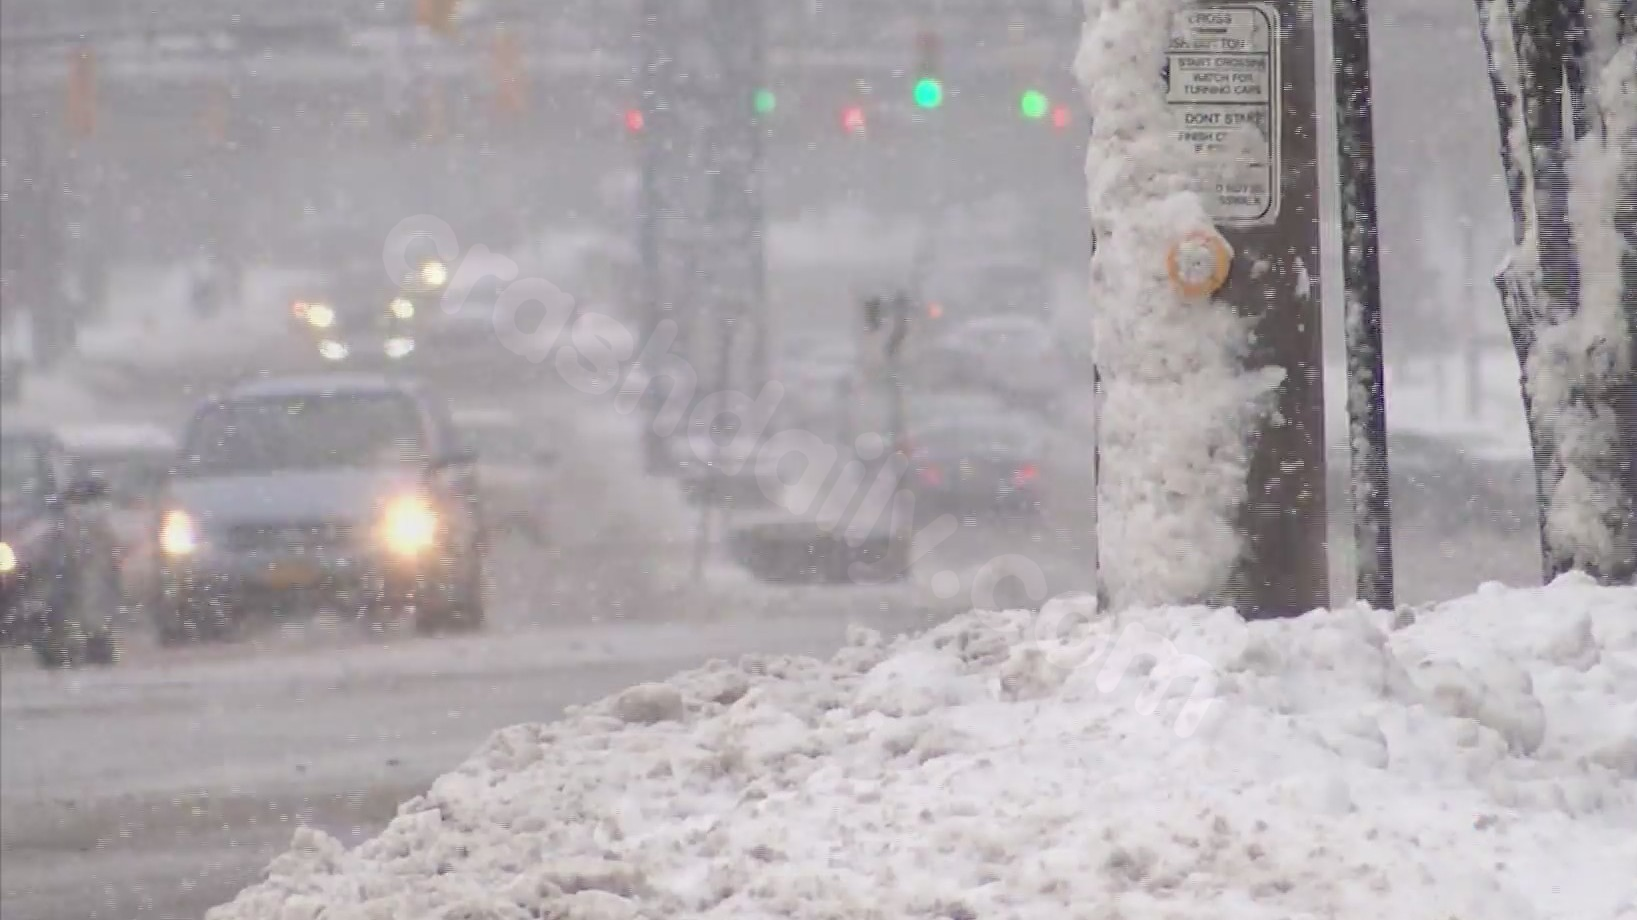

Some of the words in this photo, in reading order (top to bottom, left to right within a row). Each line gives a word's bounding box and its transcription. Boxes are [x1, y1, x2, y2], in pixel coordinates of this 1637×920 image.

[1193, 73, 1229, 82] WATCH
[1232, 73, 1253, 82] FOR
[1184, 85, 1231, 95] TURNING
[1234, 85, 1261, 95] CARS
[1185, 113, 1221, 124] DONT
